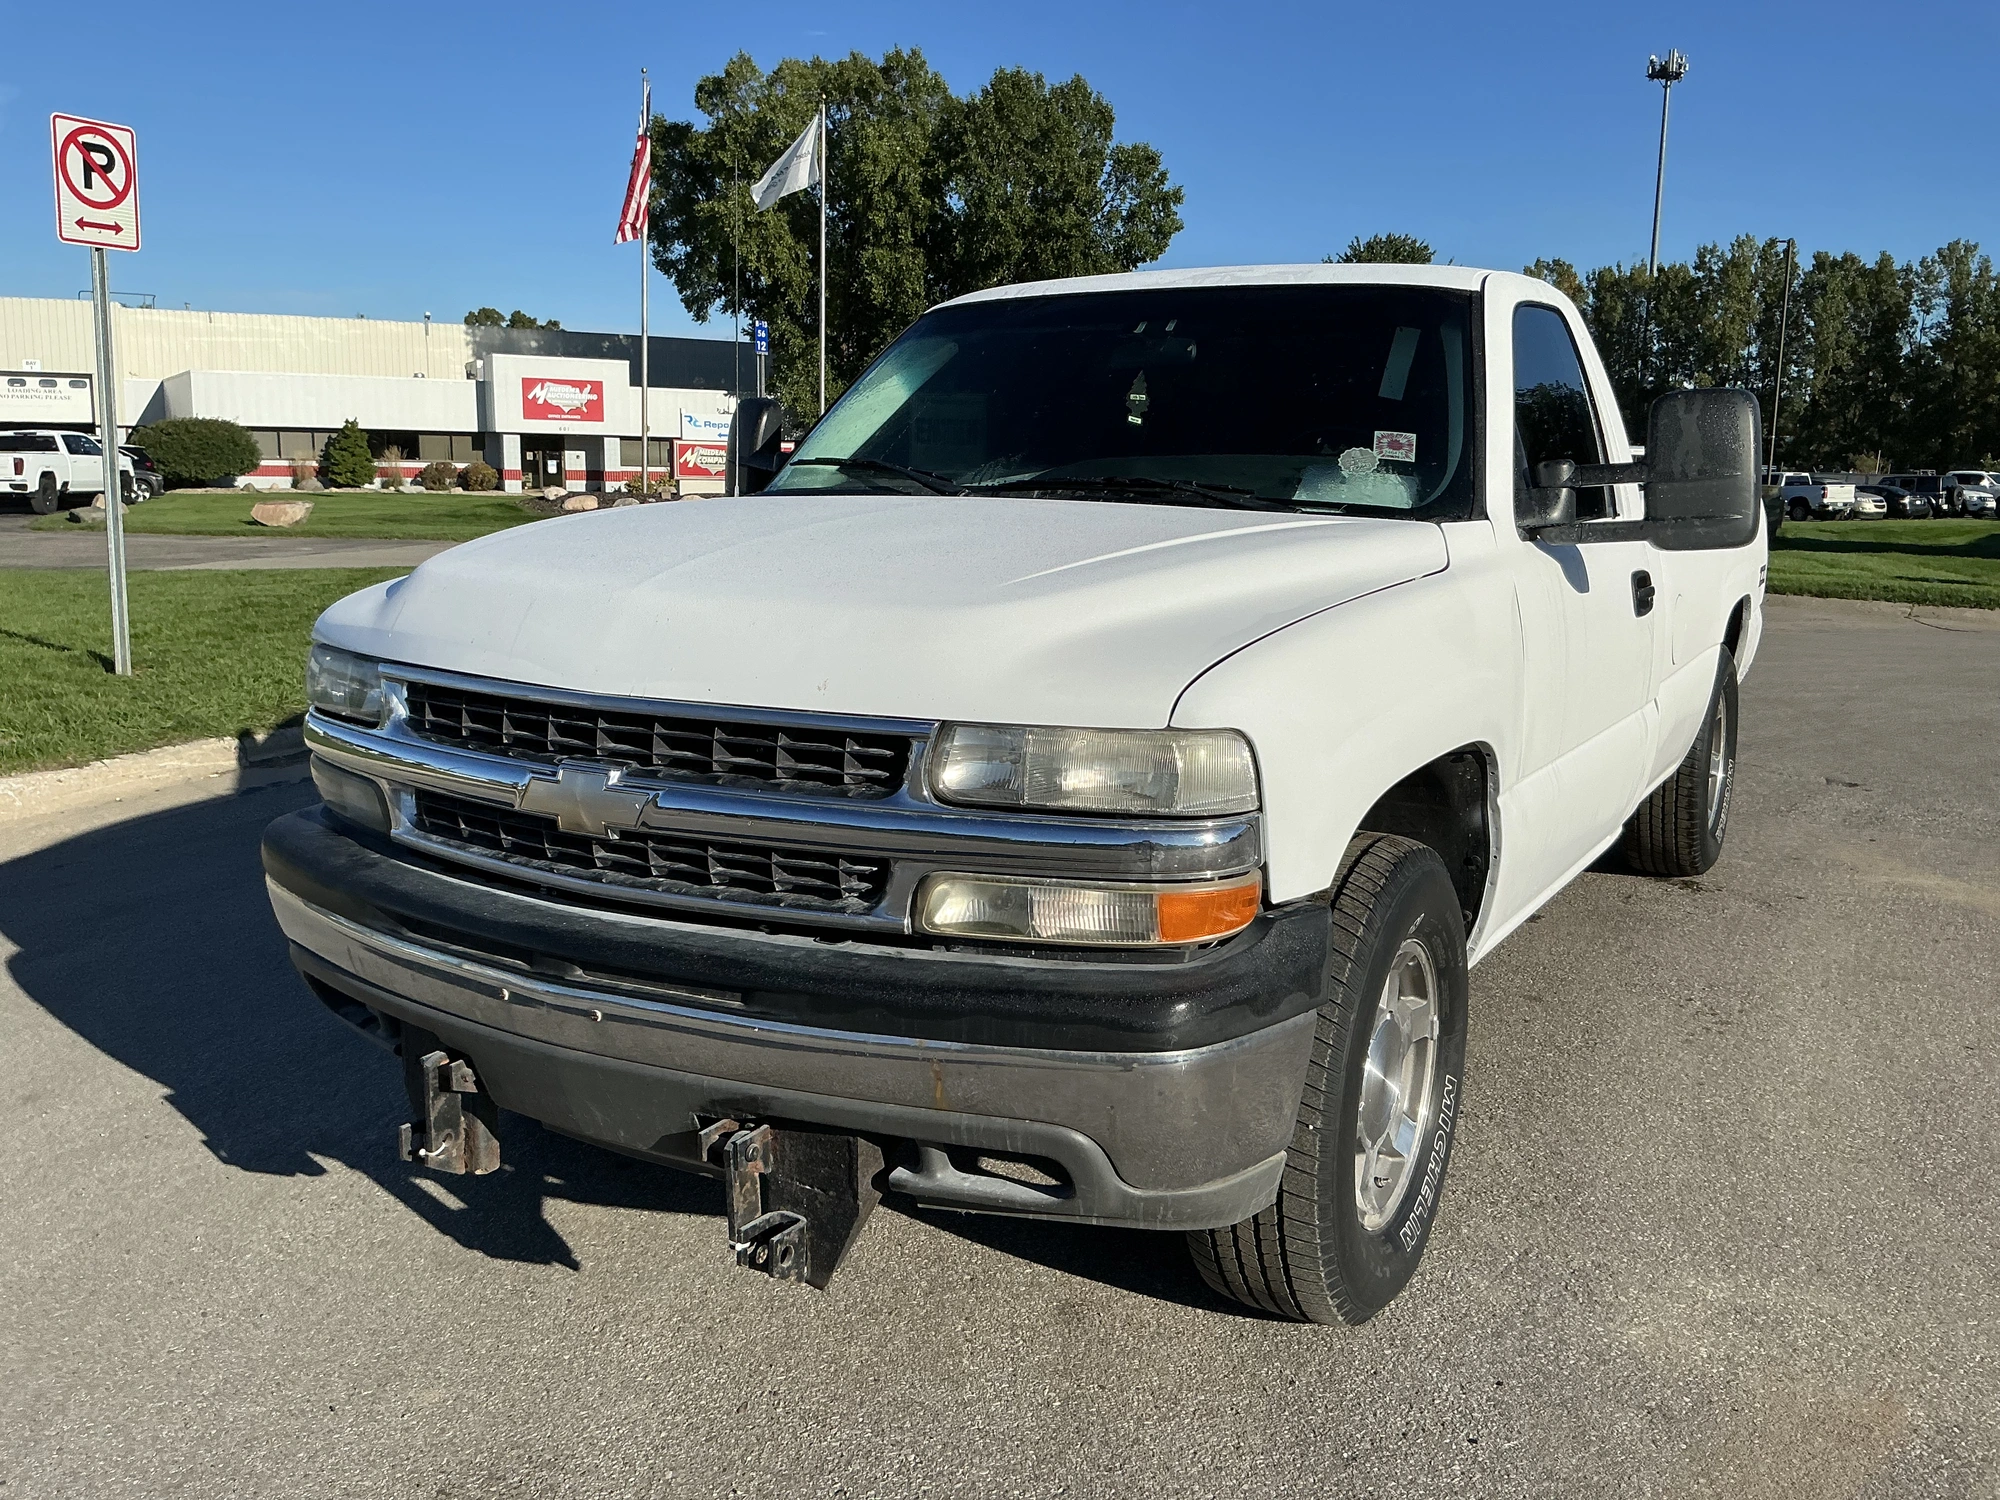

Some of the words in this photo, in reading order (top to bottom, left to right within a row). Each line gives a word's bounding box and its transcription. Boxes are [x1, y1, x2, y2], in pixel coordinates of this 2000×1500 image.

[81, 141, 116, 190] P
[757, 329, 766, 338] 56
[756, 340, 767, 351] 12
[704, 421, 730, 430] Repo
[1399, 1074, 1458, 1253] MICHELIN
